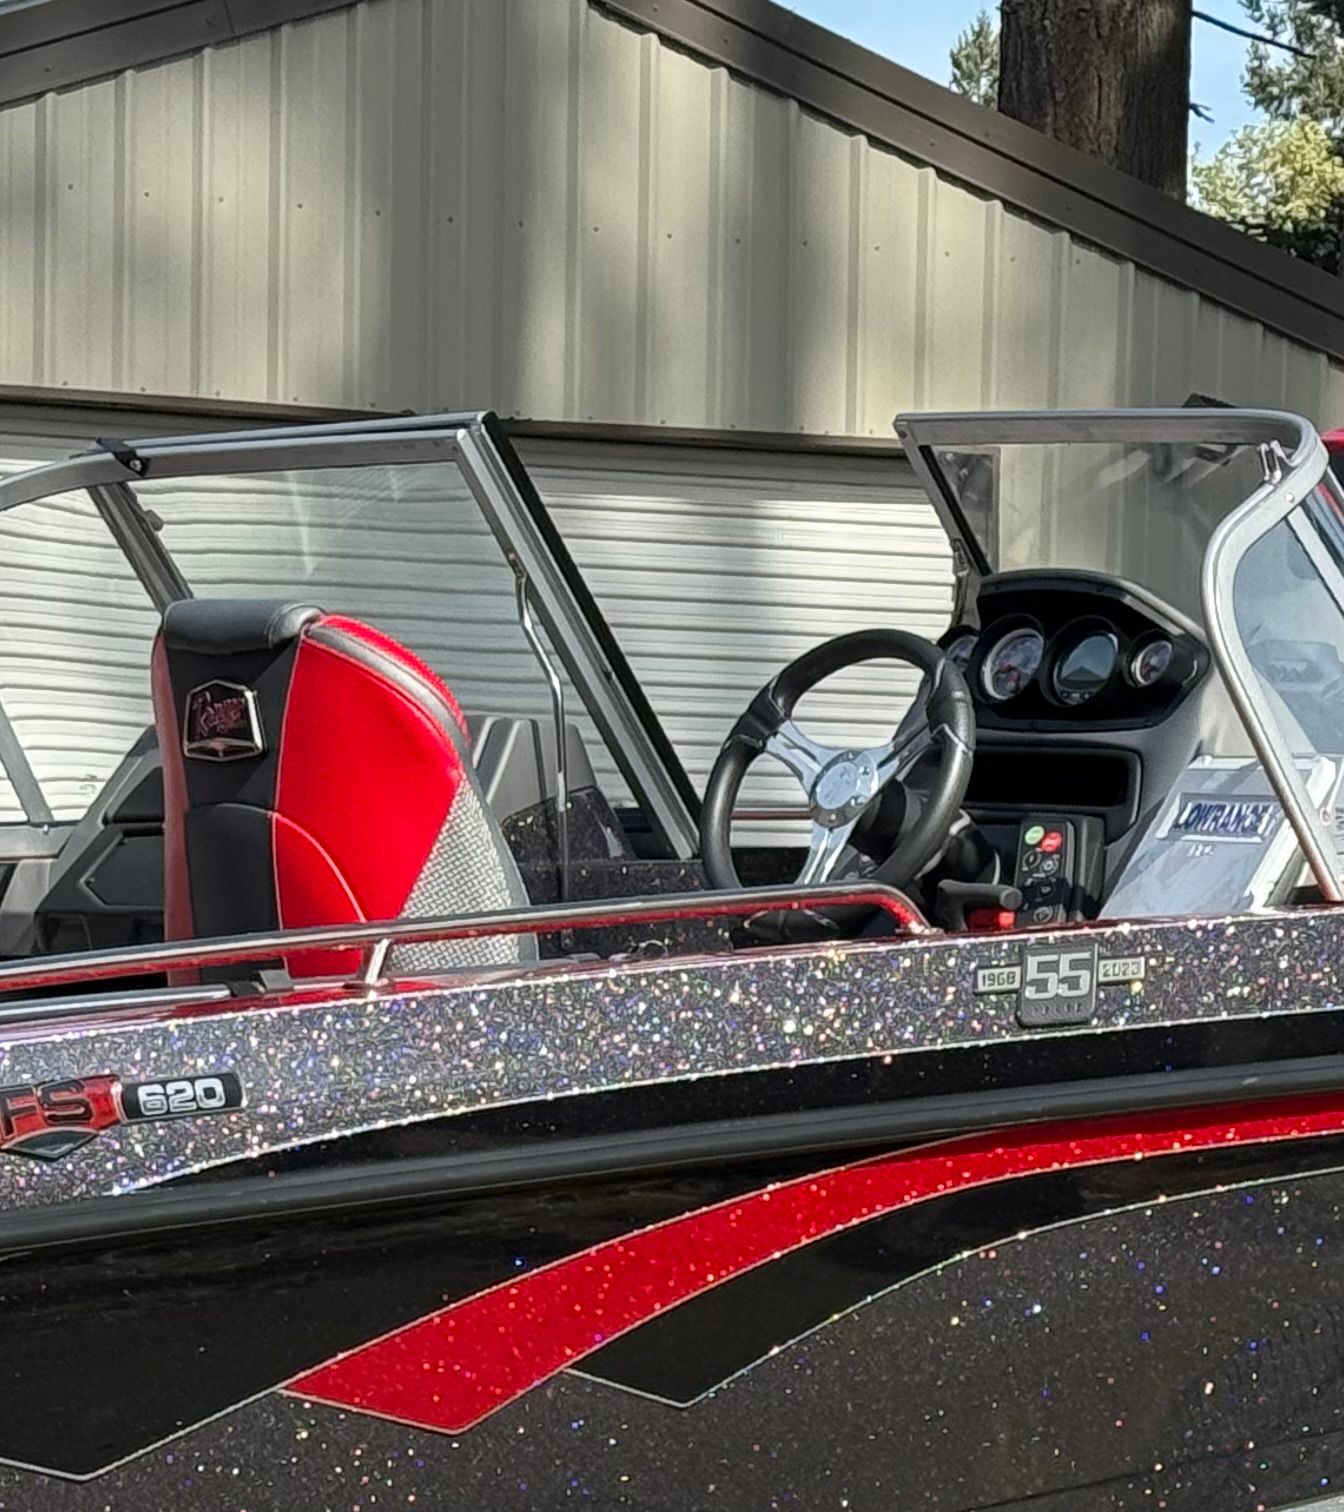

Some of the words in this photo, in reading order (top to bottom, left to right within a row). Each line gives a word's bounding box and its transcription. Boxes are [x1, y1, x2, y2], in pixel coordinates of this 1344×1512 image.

[981, 970, 1016, 987] 1968
[1025, 952, 1092, 999] 55
[137, 1077, 227, 1116] 620
